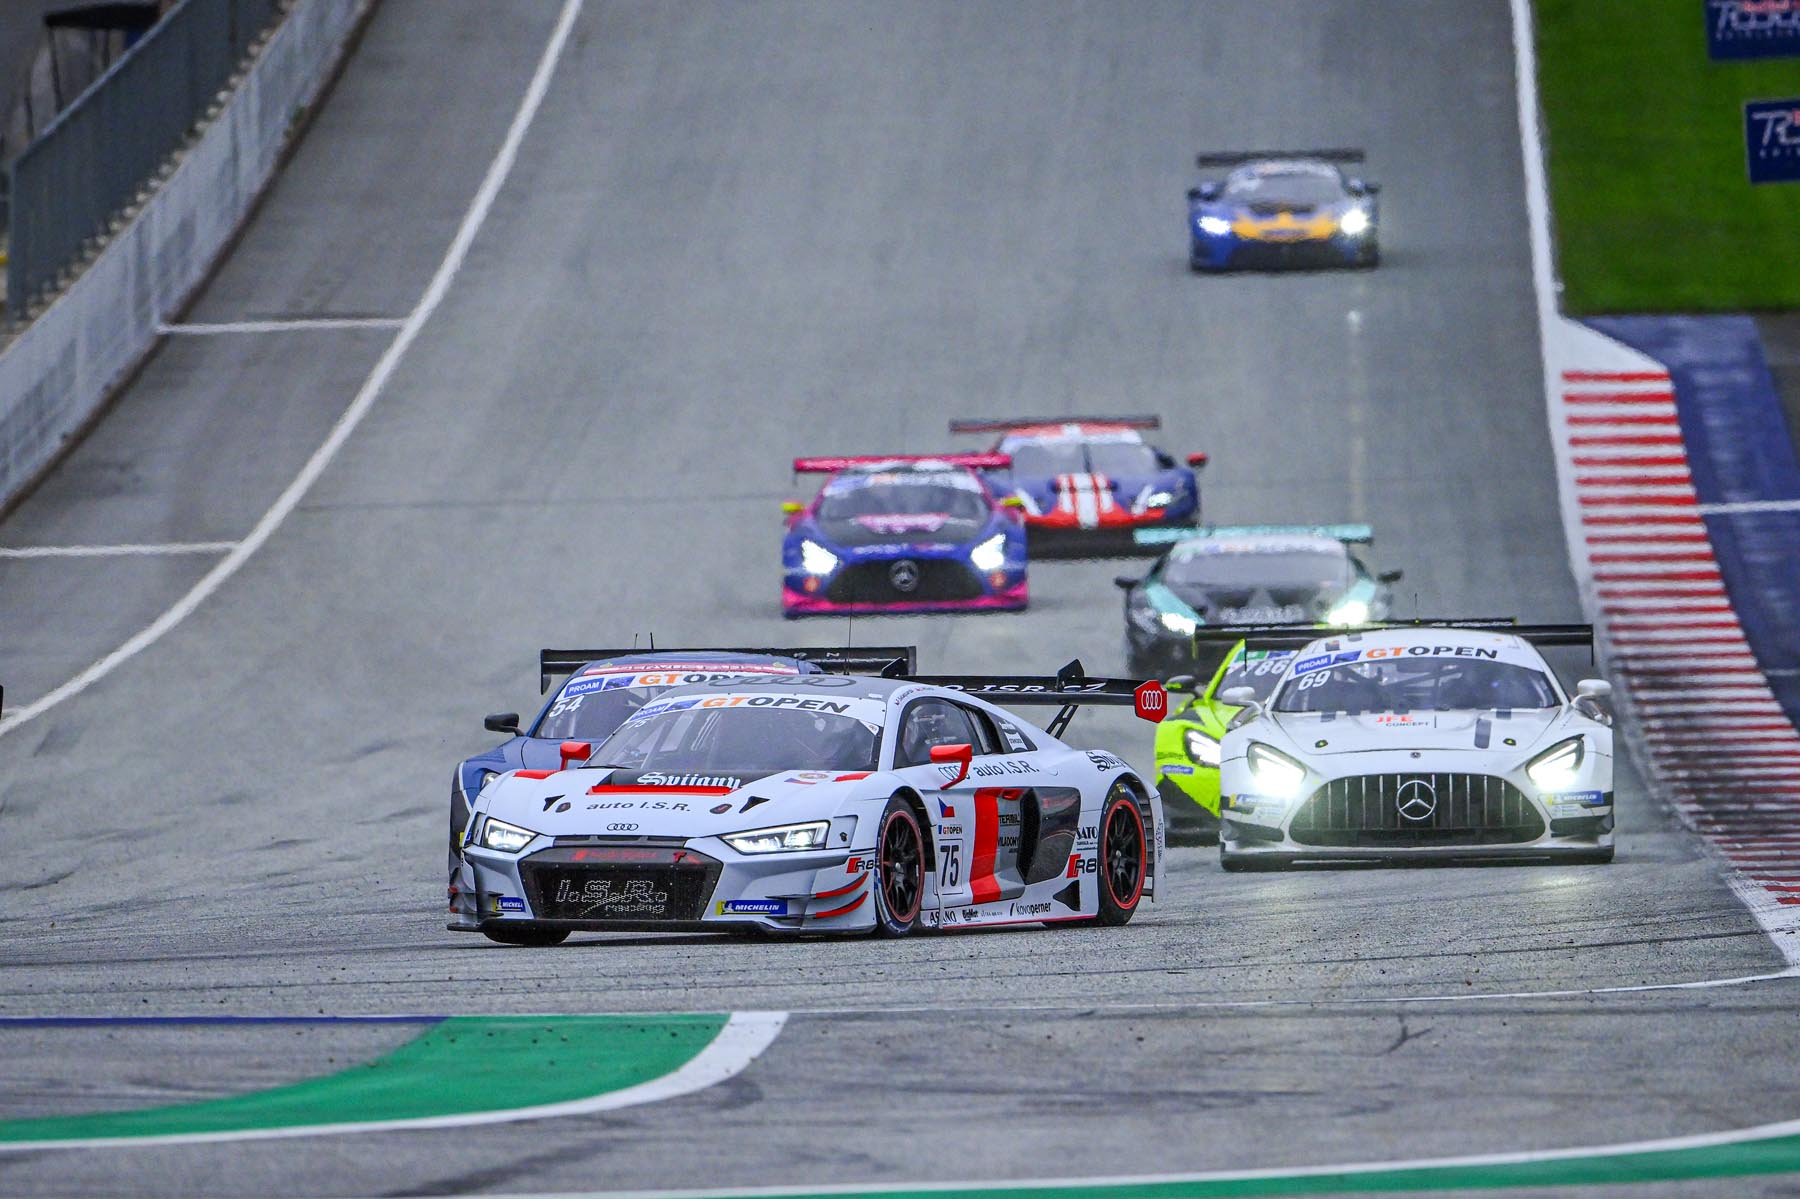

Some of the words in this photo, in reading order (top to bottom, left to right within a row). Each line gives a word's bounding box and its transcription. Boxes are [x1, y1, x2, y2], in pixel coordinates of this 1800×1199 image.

[1365, 646, 1498, 659] GTOPEN
[1298, 657, 1329, 673] PROAM
[568, 681, 600, 694] PROAM
[1299, 670, 1331, 691] 69
[549, 695, 585, 718] 54
[702, 697, 850, 713] GTOPEN
[976, 764, 1001, 777] auto
[1000, 760, 1040, 775] I.S.R.
[587, 801, 634, 811] auto
[639, 801, 692, 812] I.S.R.
[855, 860, 875, 871] R8
[940, 845, 960, 887] 75
[1075, 858, 1097, 874] R8
